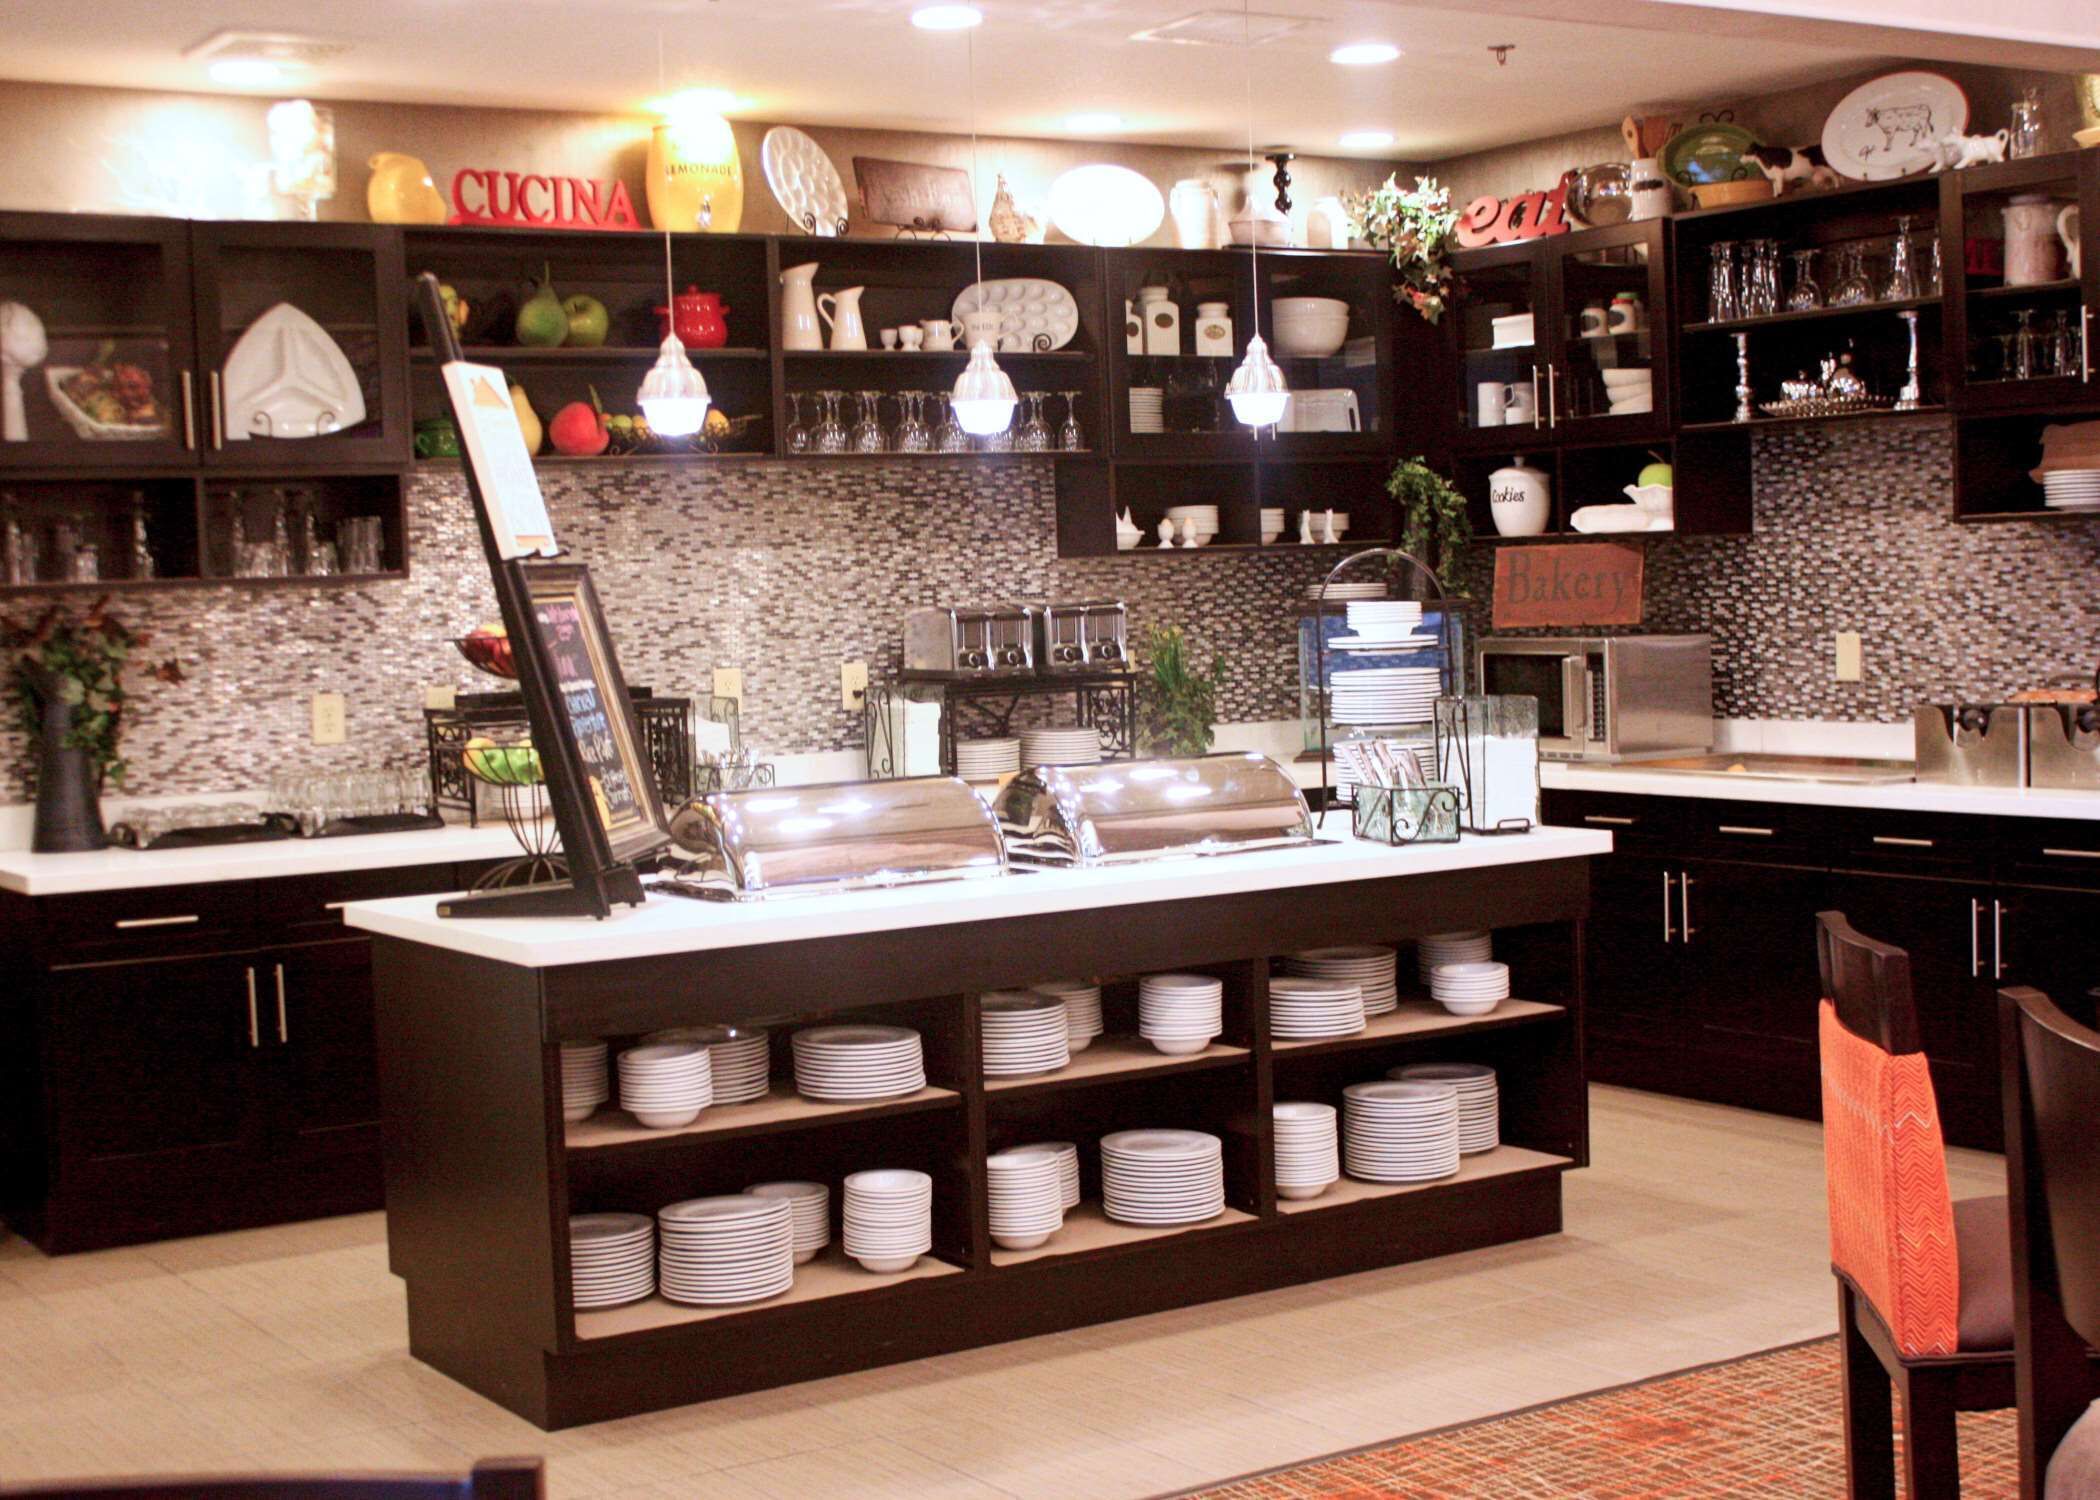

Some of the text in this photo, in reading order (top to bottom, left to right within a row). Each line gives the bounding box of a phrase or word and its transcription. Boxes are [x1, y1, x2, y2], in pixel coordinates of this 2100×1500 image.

[452, 168, 641, 228] CUCINA
[1456, 168, 1578, 248] eat
[1492, 486, 1526, 503] Cookies
[1507, 553, 1625, 614] Bakery
